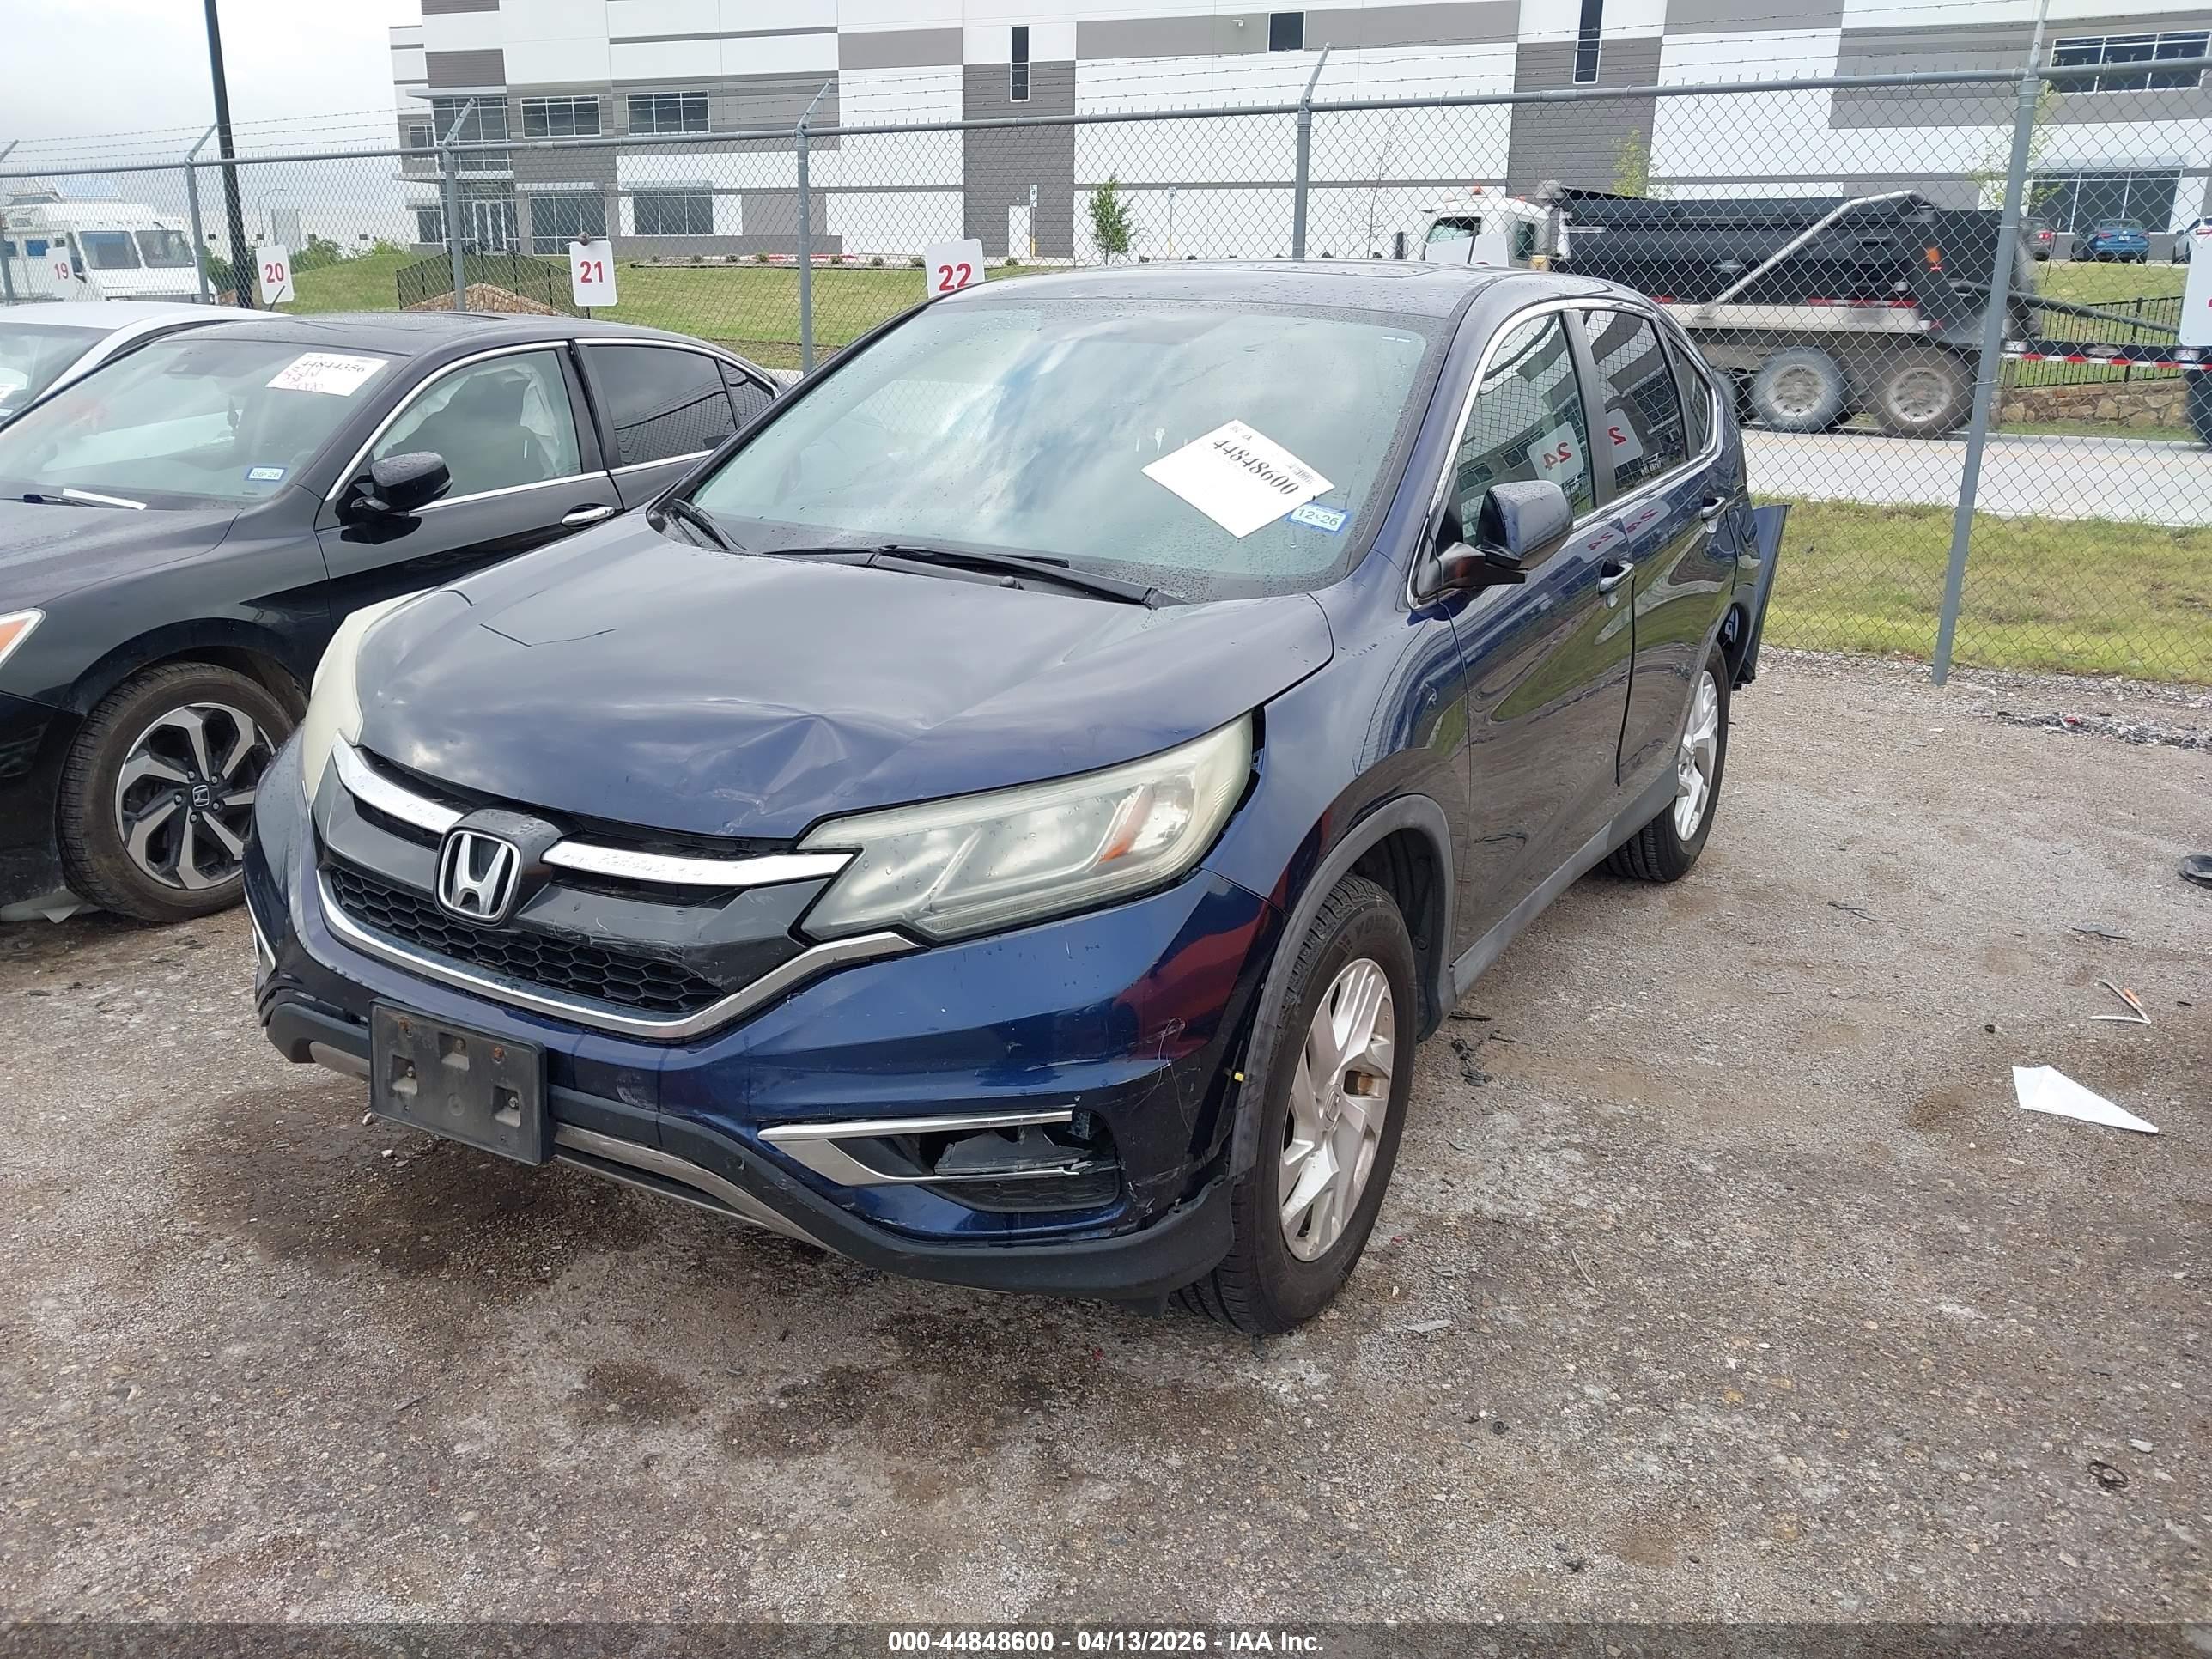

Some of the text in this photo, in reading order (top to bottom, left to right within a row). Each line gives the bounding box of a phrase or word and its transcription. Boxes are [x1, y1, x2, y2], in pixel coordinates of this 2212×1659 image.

[53, 262, 69, 280] 19
[264, 262, 285, 283] 20
[580, 260, 604, 283] 21
[938, 263, 972, 291] 22
[1212, 440, 1300, 495] 44848600
